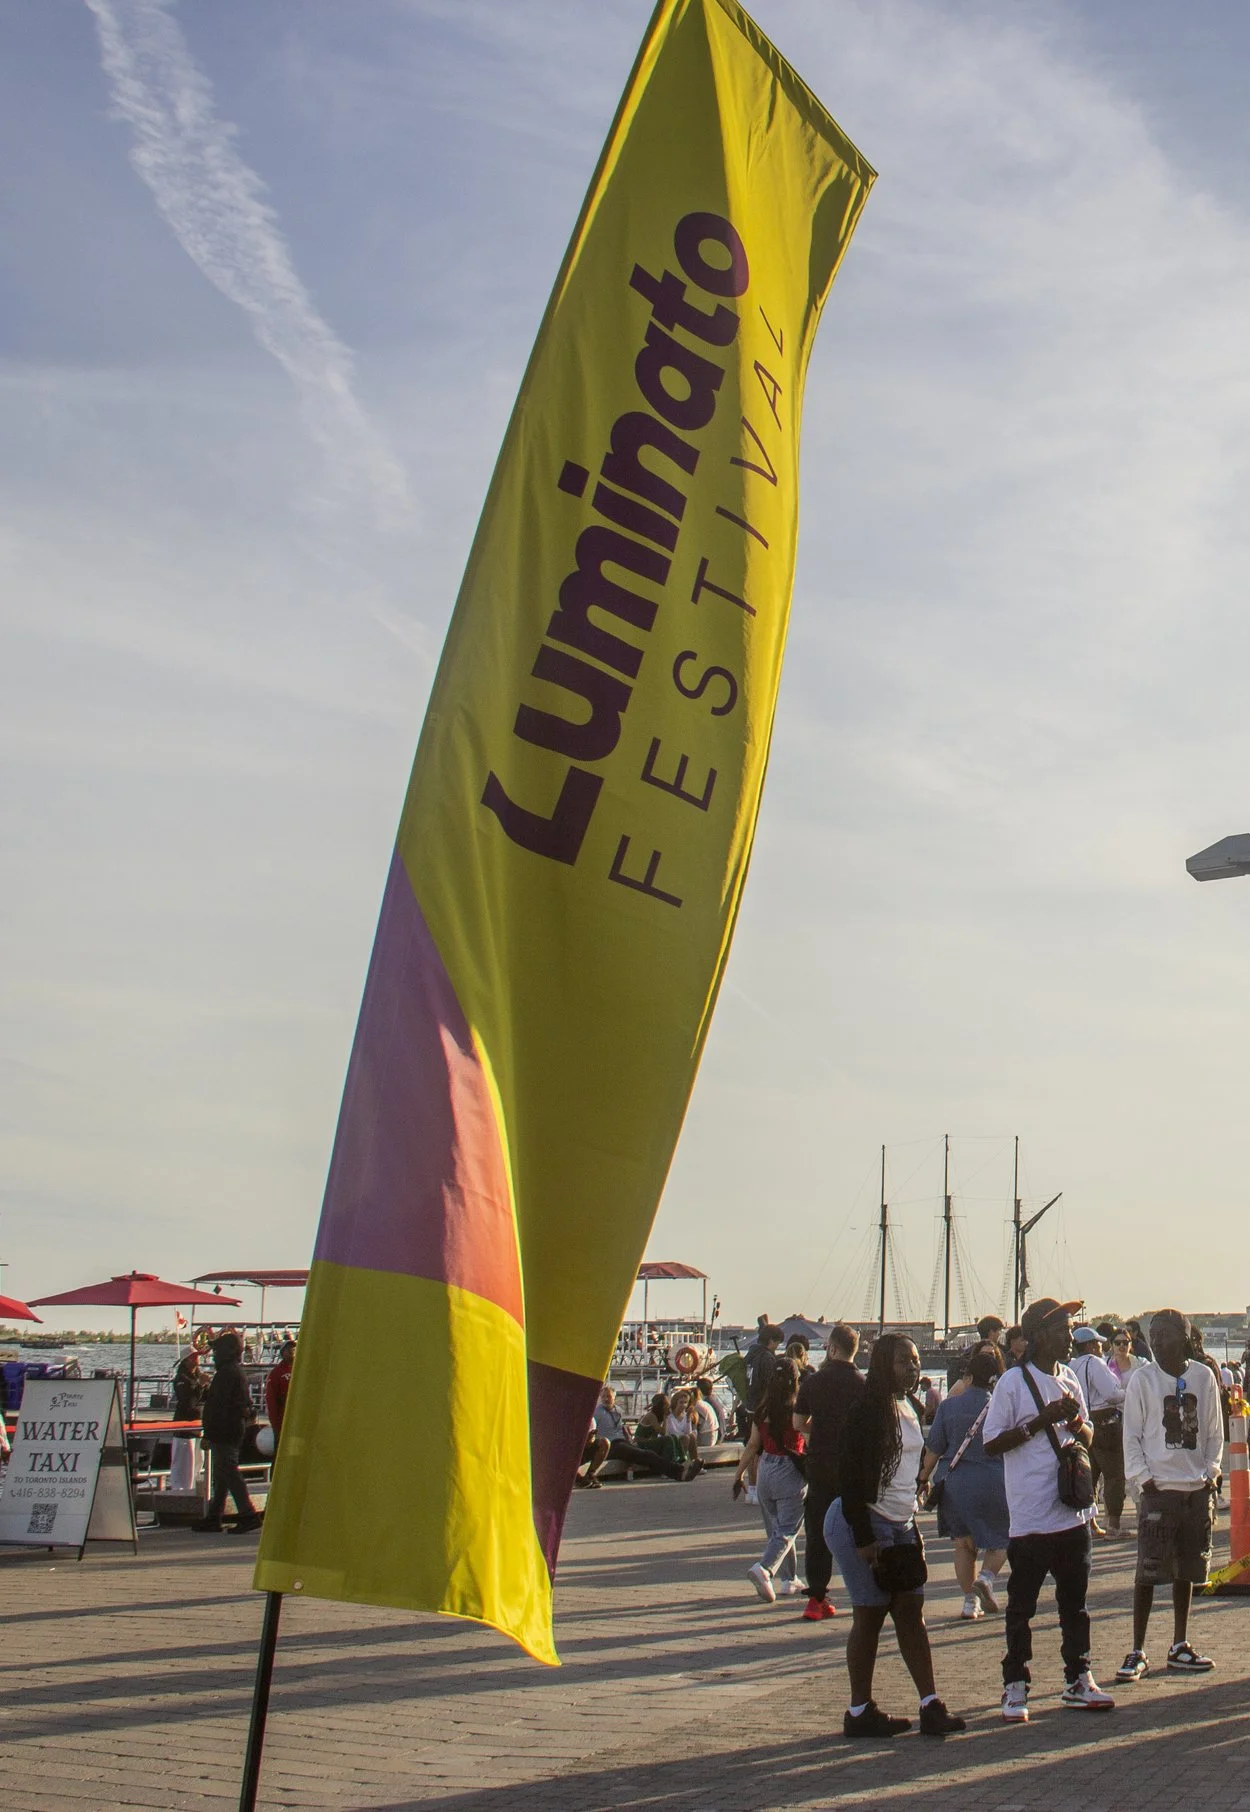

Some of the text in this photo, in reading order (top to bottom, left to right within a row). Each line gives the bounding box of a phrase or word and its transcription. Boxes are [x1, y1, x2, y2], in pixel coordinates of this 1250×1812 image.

[480, 210, 750, 867] Luminato
[607, 304, 785, 909] FESTIVAL
[22, 1421, 99, 1441] WATER
[28, 1452, 81, 1472] TAXI
[14, 1476, 88, 1484] TO TORONTO ISLANDS
